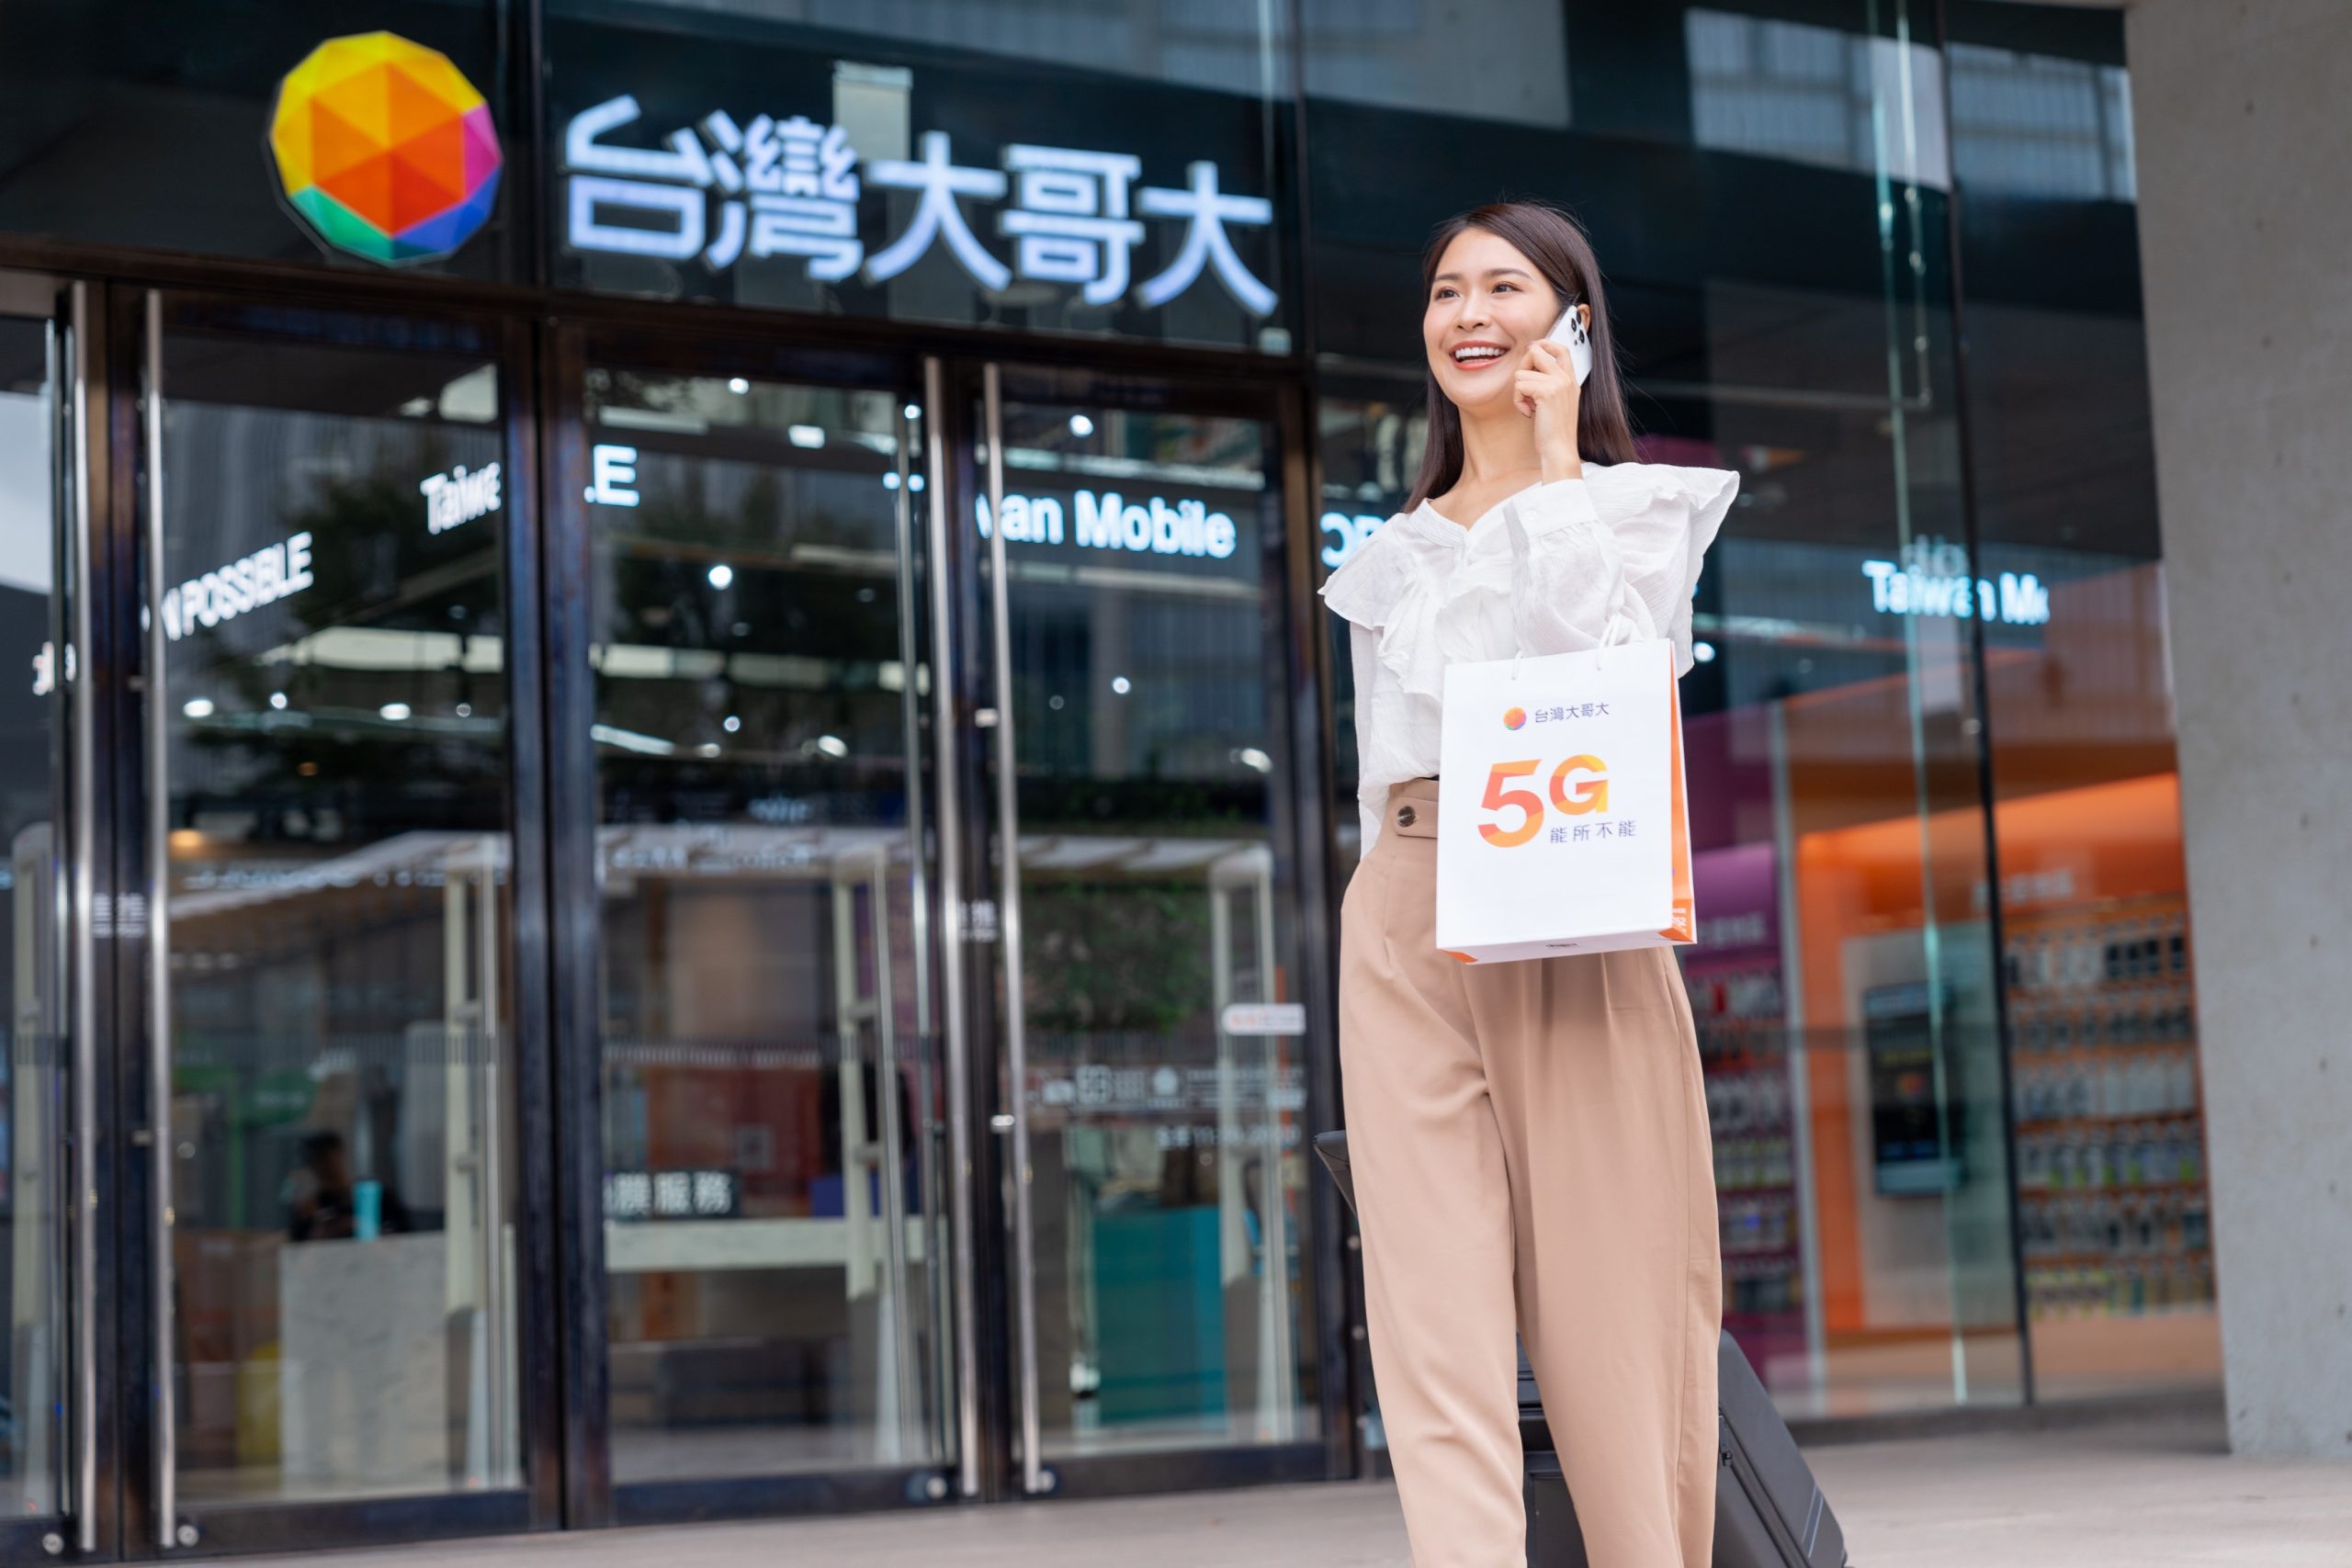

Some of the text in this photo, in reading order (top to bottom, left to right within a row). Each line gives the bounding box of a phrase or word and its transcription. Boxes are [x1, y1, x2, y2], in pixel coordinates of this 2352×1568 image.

[564, 94, 1280, 318] 台灣大哥大
[1073, 489, 1237, 558] Mobile
[1534, 702, 1610, 724] 台灣大哥大
[1476, 753, 1610, 849] 5G
[1549, 820, 1637, 844] 能所不能
